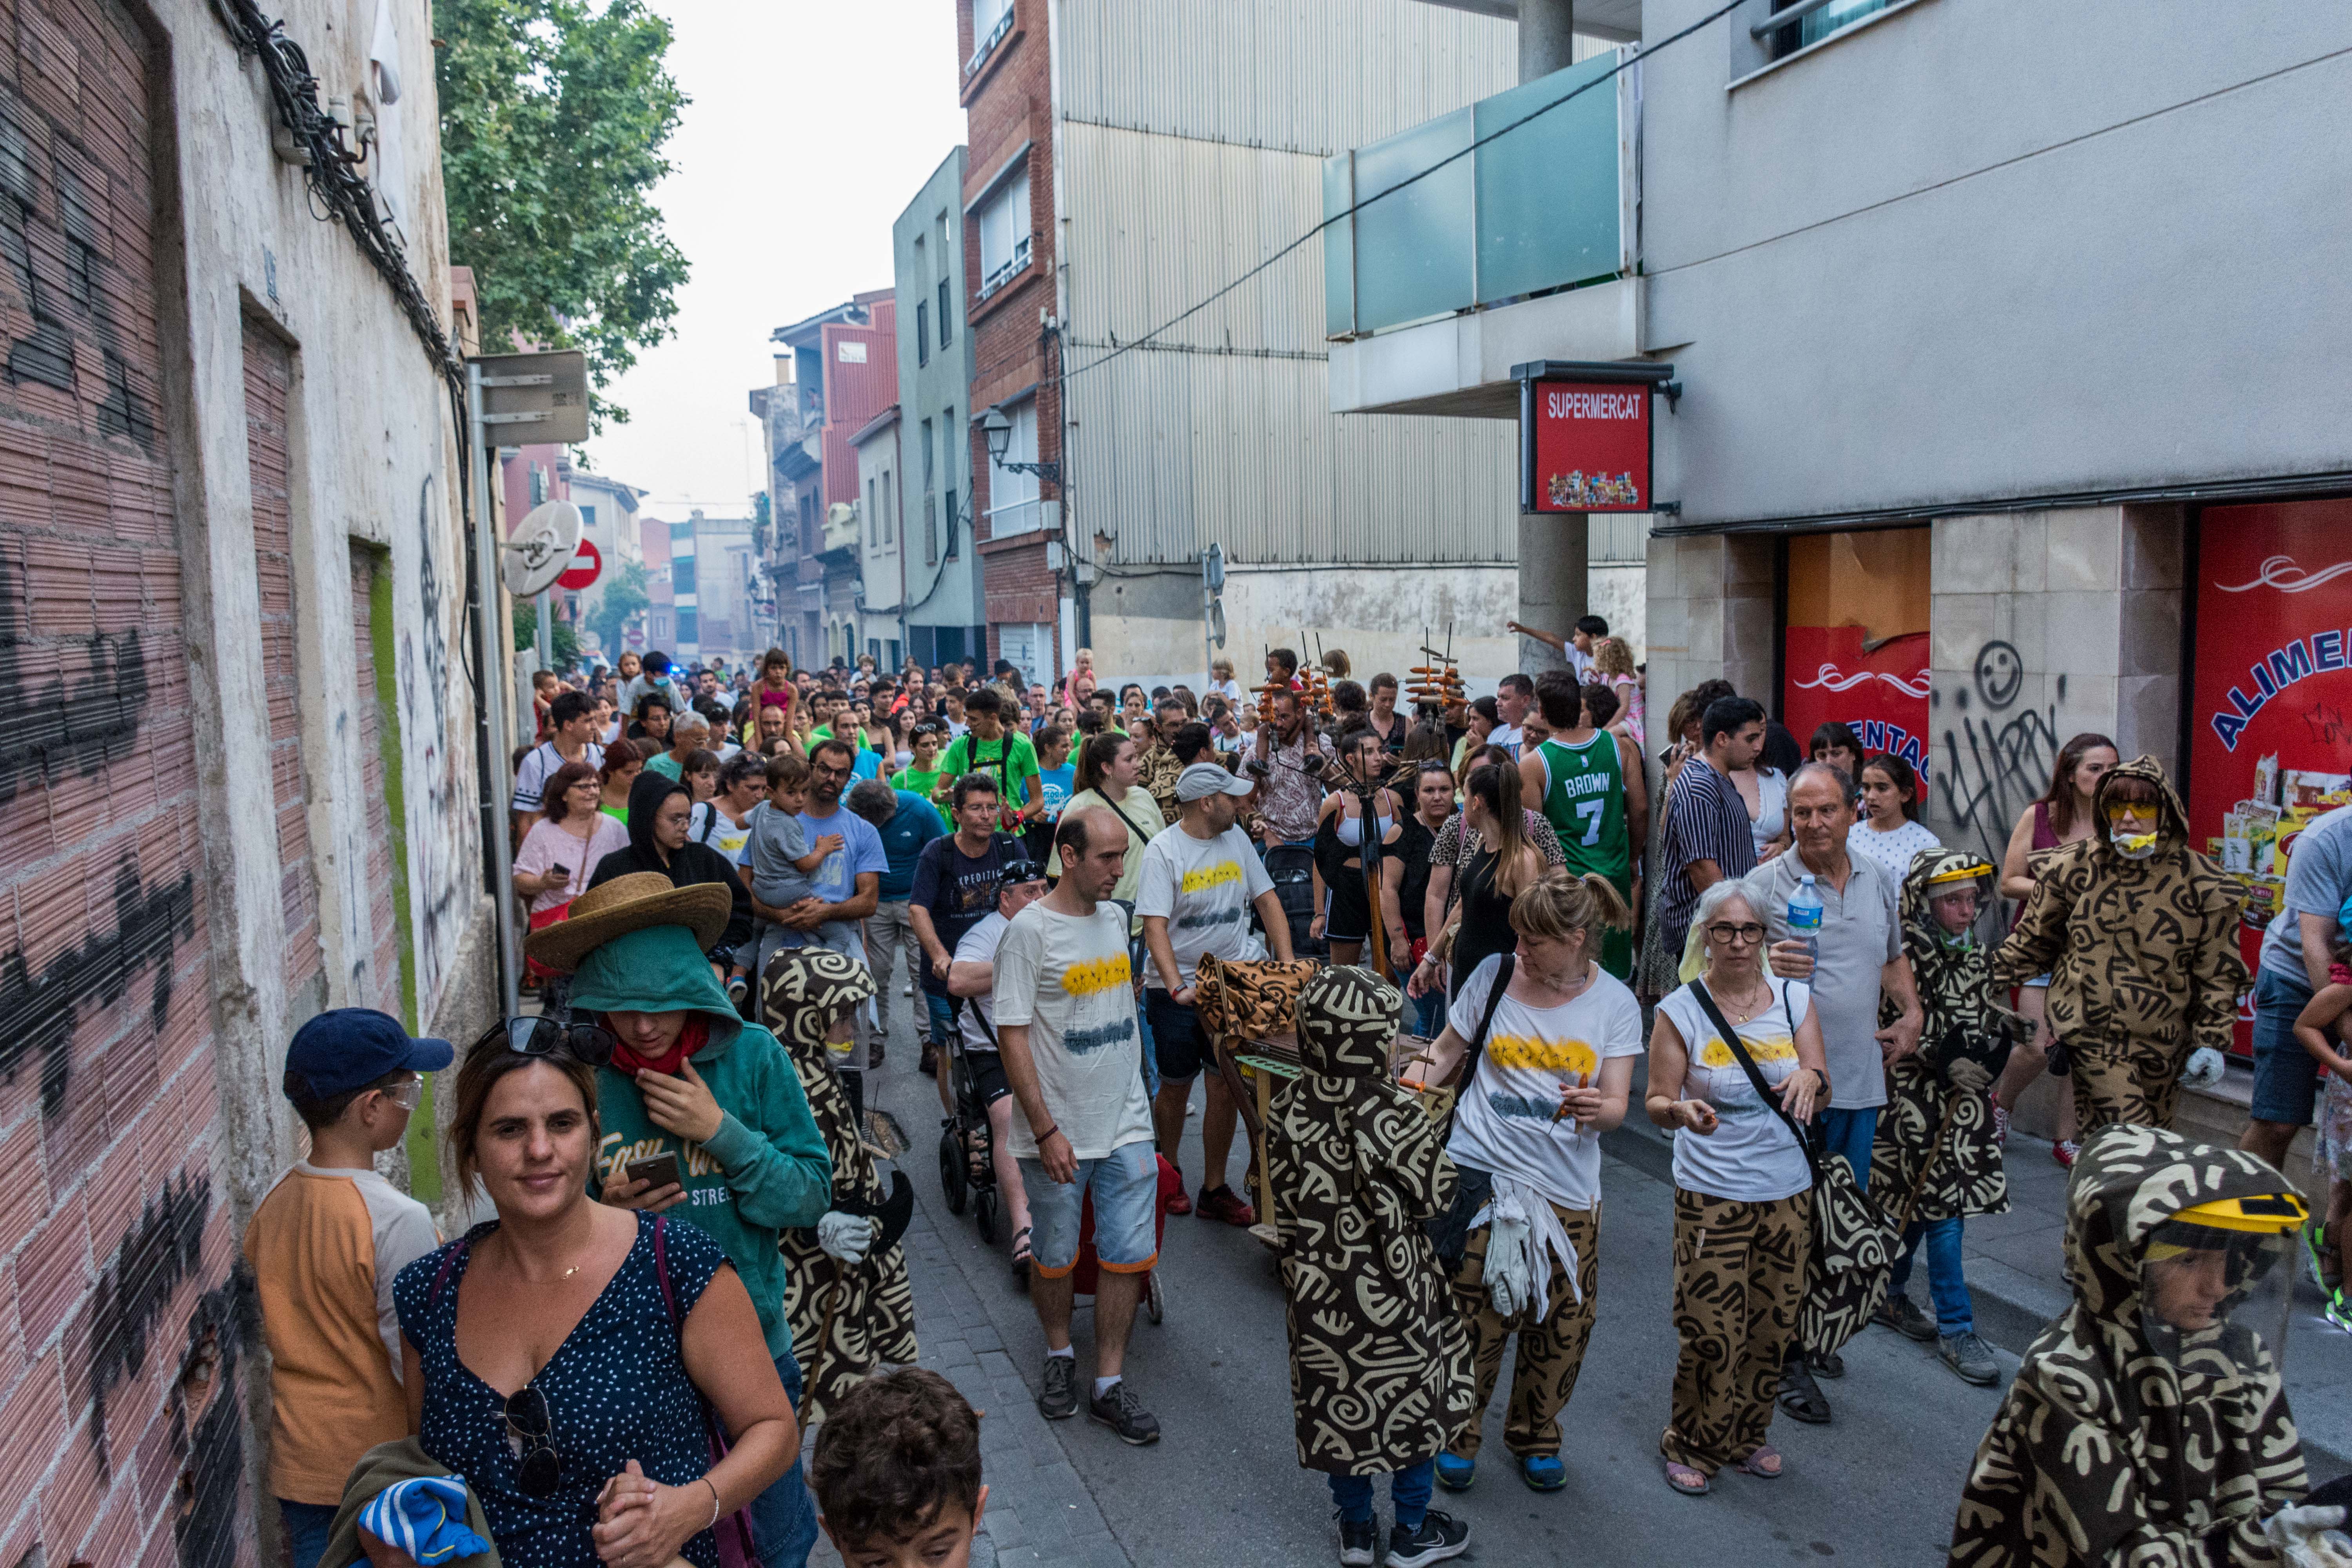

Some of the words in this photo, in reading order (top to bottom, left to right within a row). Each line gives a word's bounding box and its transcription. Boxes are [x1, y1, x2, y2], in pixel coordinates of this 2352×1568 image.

[1548, 392, 1641, 419] SUPERMERCAT
[2210, 628, 2352, 753] ALIME
[1564, 772, 1610, 798] BROWN
[1576, 798, 1604, 846] 7
